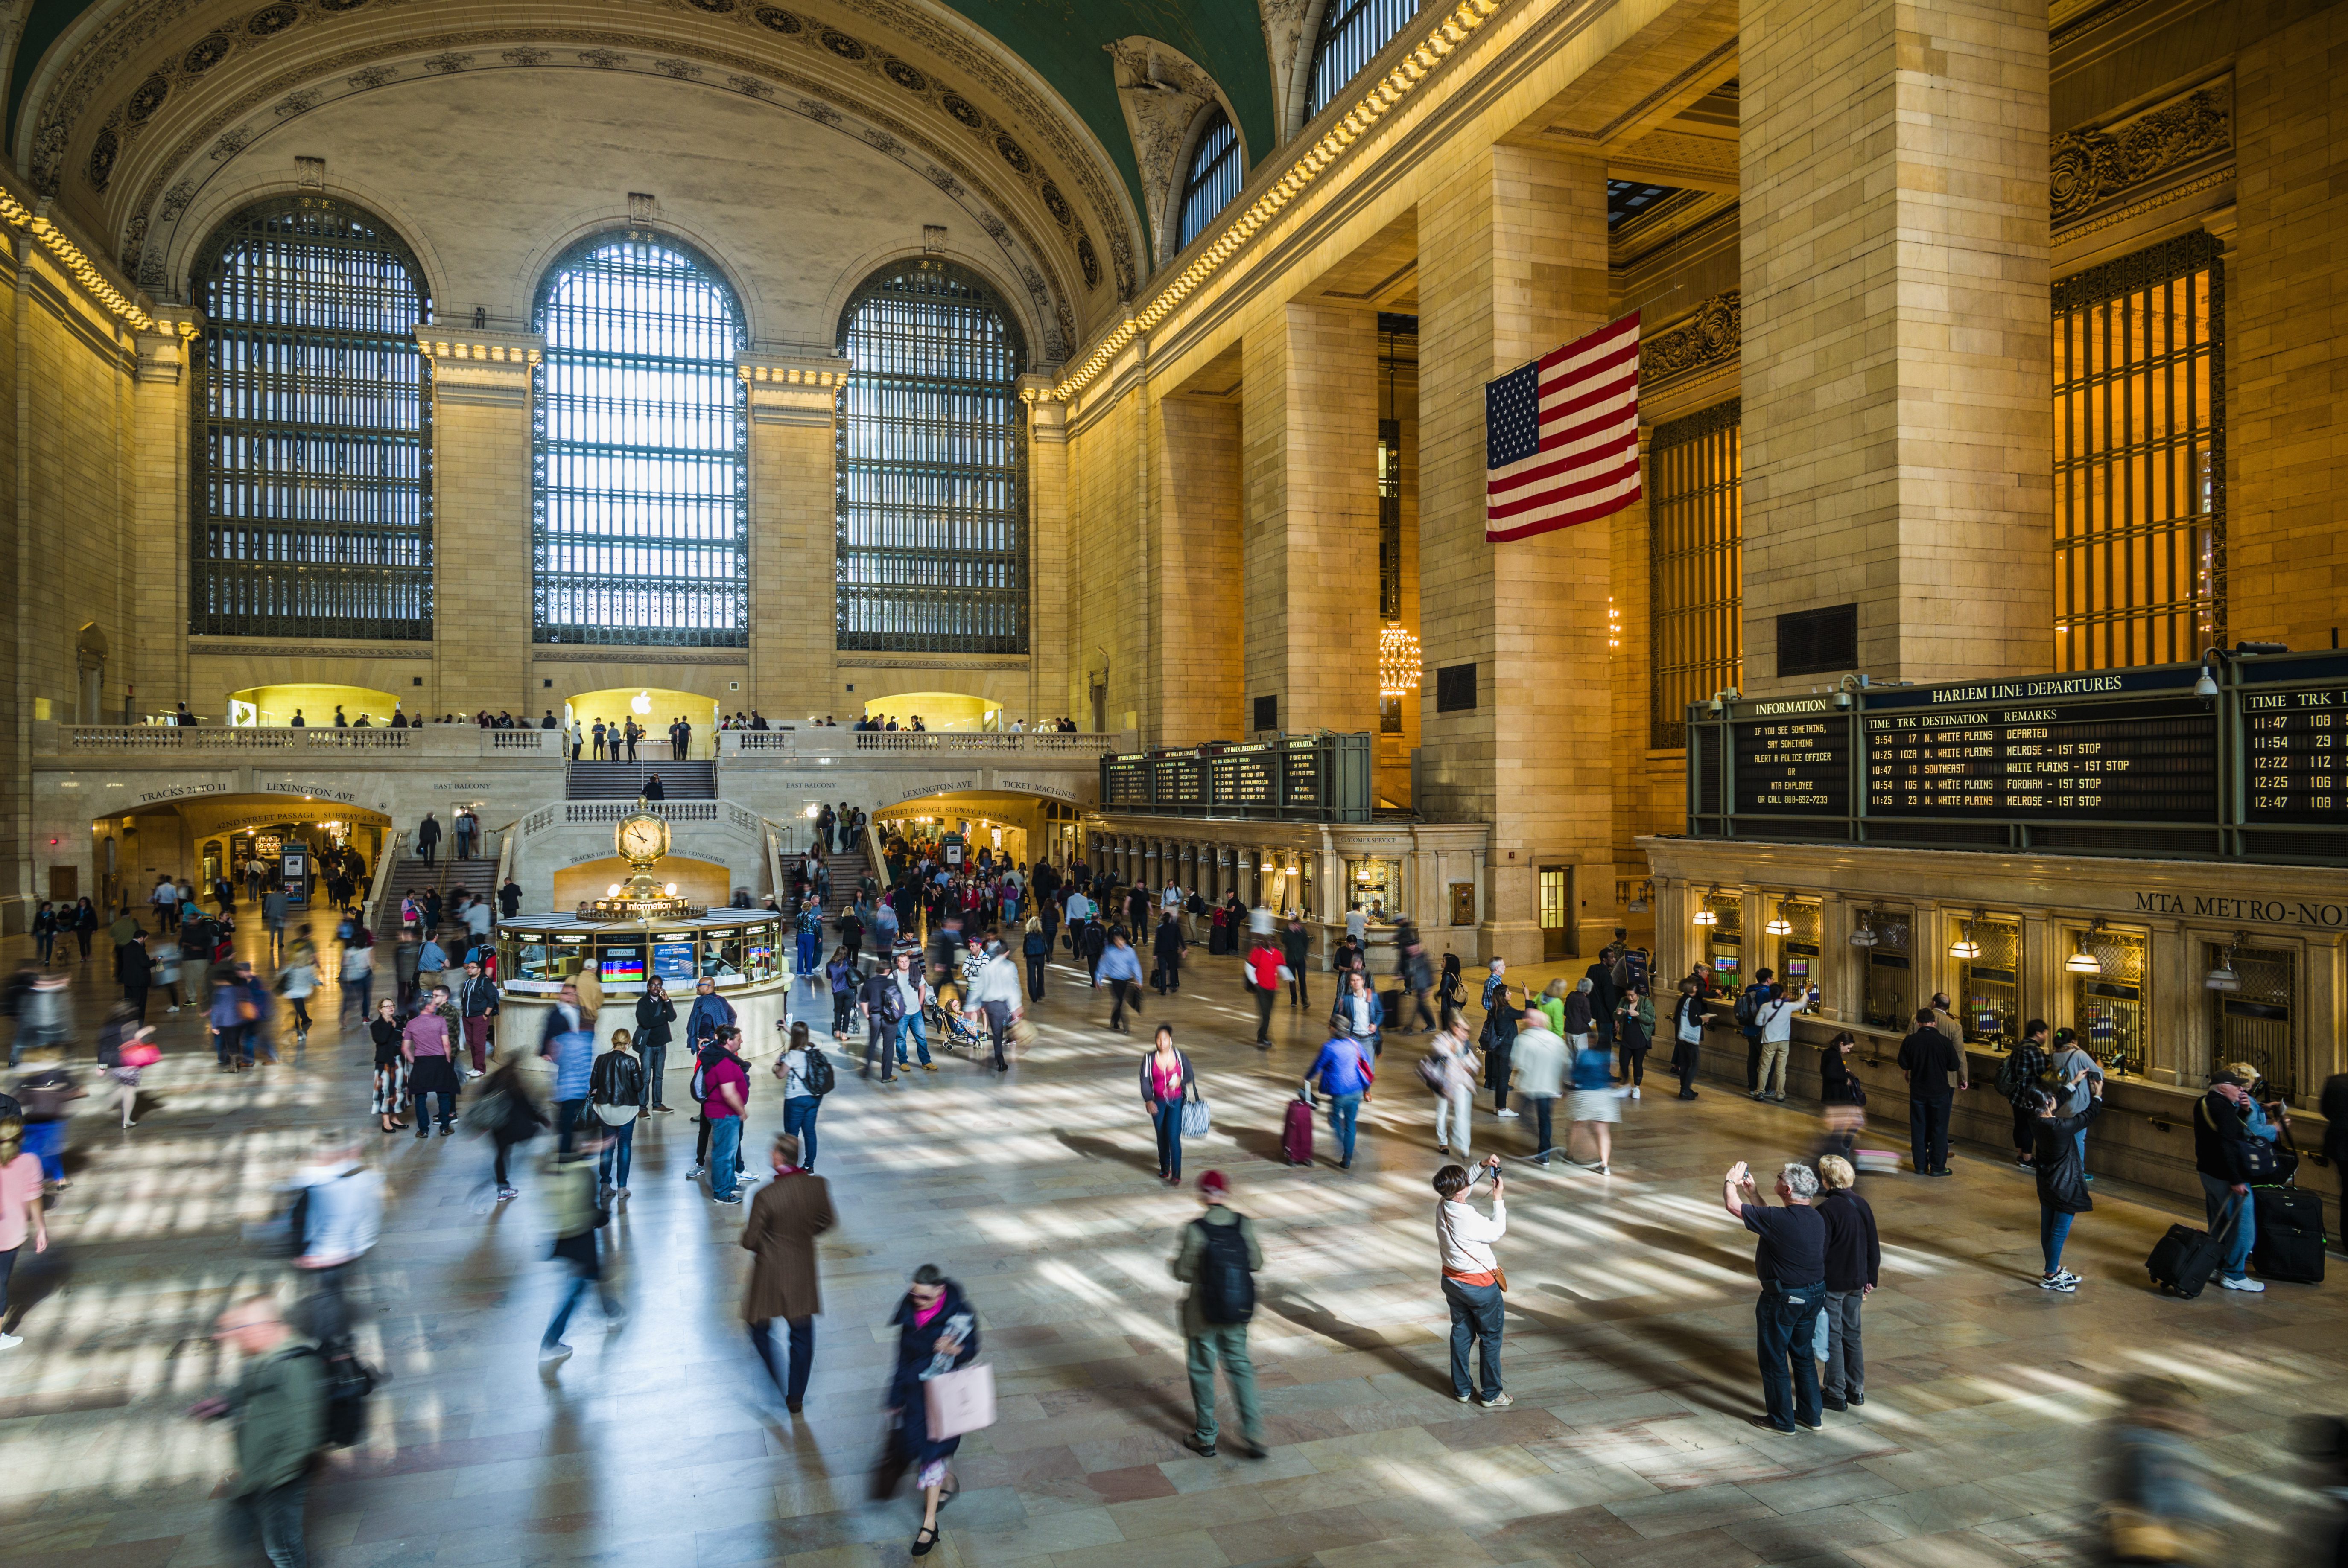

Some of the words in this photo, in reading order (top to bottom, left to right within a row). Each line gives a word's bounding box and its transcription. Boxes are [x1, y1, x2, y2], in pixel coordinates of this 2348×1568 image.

[1933, 687, 1987, 702] HARLEM
[1992, 684, 2023, 698] LINE
[2027, 676, 2122, 696] DEPARTURES
[1756, 699, 1826, 714] INFORMATION
[2249, 695, 2286, 708] TIME
[2298, 693, 2332, 705] TRK
[1869, 719, 1890, 729] TIME
[1897, 717, 1916, 727] TRK
[1922, 713, 1988, 726] DESTINATION
[2004, 709, 2057, 721] REMARKS
[2255, 717, 2287, 729] 11:47
[2310, 715, 2330, 726] 108
[1765, 727, 1774, 735] YOU
[1791, 724, 1826, 734] SOMETHING,
[1875, 735, 1892, 744] 9:54
[1909, 734, 1916, 743] 17
[1925, 733, 1933, 742] N.
[1938, 732, 1960, 742] WHITE
[1965, 731, 1993, 740] PLAINS
[2007, 728, 2047, 739] DEPARTED
[1767, 740, 1778, 749] SAY
[1781, 739, 1813, 748] SOMETHING
[2255, 737, 2287, 748] 11:54
[2316, 735, 2330, 746] 29
[1755, 754, 1771, 763] ALERT
[1781, 753, 1802, 762] POLICE
[1805, 752, 1831, 761] OFFICER
[1872, 750, 1892, 760] 10:25
[1900, 749, 1917, 759] 102A
[1925, 749, 1933, 758] N.
[1938, 748, 1960, 757] WHITE
[1965, 747, 1993, 757] PLAINS
[2007, 745, 2042, 755] MELROSE
[2059, 744, 2073, 755] 1ST
[2079, 743, 2101, 754] STOP
[1872, 766, 1892, 775] 10:47
[1909, 765, 1917, 774] 18
[1925, 764, 1965, 773] SOUTHEAST
[2007, 763, 2032, 772] WHITE
[2037, 761, 2068, 772] PLAINS
[2085, 761, 2101, 771] 1ST
[2106, 760, 2129, 770] STOP
[2255, 757, 2287, 768] 12:22
[2311, 756, 2330, 767] 112
[1771, 781, 1781, 790] MTA
[1784, 781, 1813, 790] EMPLOYEE
[1872, 781, 1892, 790] 10:54
[1905, 781, 1917, 790] 105
[1925, 781, 1933, 790] N.
[1938, 780, 1960, 789] WHITE
[1965, 780, 1993, 789] PLAINS
[2007, 779, 2042, 789] FORDHAM
[2059, 778, 2073, 789] 1ST
[2079, 778, 2101, 789] STOP
[2255, 776, 2288, 788] 12:25
[2311, 776, 2331, 788] 106
[140, 787, 184, 801] TRACKS
[267, 783, 332, 797] LEXINGTON
[335, 792, 355, 801] AVE
[902, 783, 953, 798] LEXINGTON
[1003, 781, 1031, 789] TICKET
[1035, 784, 1076, 799] MACHINES
[1758, 796, 1765, 804] OR
[1768, 796, 1781, 804] CALL
[1872, 796, 1892, 805] 11:25
[1908, 796, 1917, 805] 23
[1925, 796, 1933, 805] N.
[1938, 796, 1960, 805] WHITE
[1965, 796, 1993, 805] PLAINS
[2007, 796, 2042, 806] MELROSE
[2059, 796, 2073, 806] 1ST
[2079, 796, 2101, 806] STOP
[2255, 796, 2288, 807] 12:47
[2311, 796, 2331, 808] 108
[882, 808, 908, 817] STREET
[217, 819, 240, 829] 42ND
[242, 814, 275, 824] STREET
[324, 812, 360, 820] SUBWAY
[570, 852, 595, 863] TRACKS
[689, 850, 726, 864] CONCOURSE
[627, 902, 671, 910] Information
[2135, 892, 2186, 913] MTA
